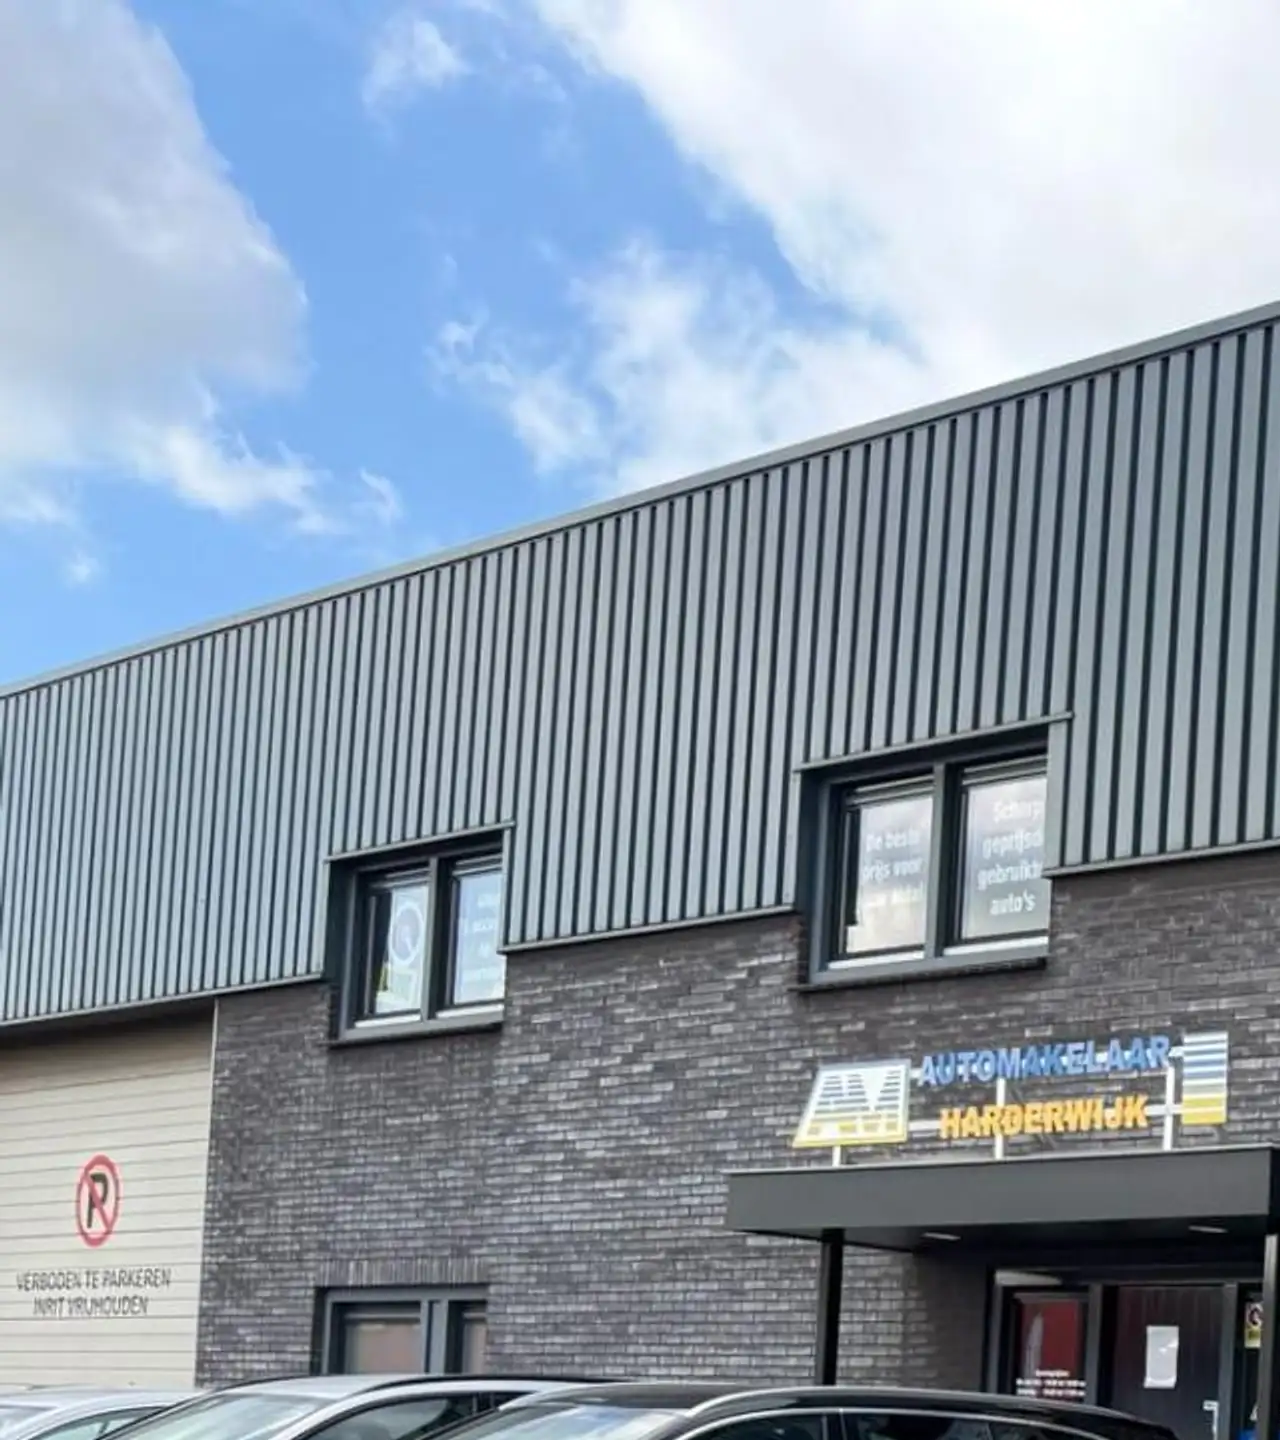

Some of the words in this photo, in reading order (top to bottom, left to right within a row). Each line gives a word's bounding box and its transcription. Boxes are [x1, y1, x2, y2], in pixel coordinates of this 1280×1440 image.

[918, 1034, 1170, 1087] AUTOMAKELAAR
[939, 1094, 1148, 1139] HARDERWIJK
[17, 1271, 81, 1291] VERBODEN
[85, 1269, 99, 1289] TE
[102, 1267, 171, 1288] PARKEREN
[34, 1297, 64, 1317] INRIT
